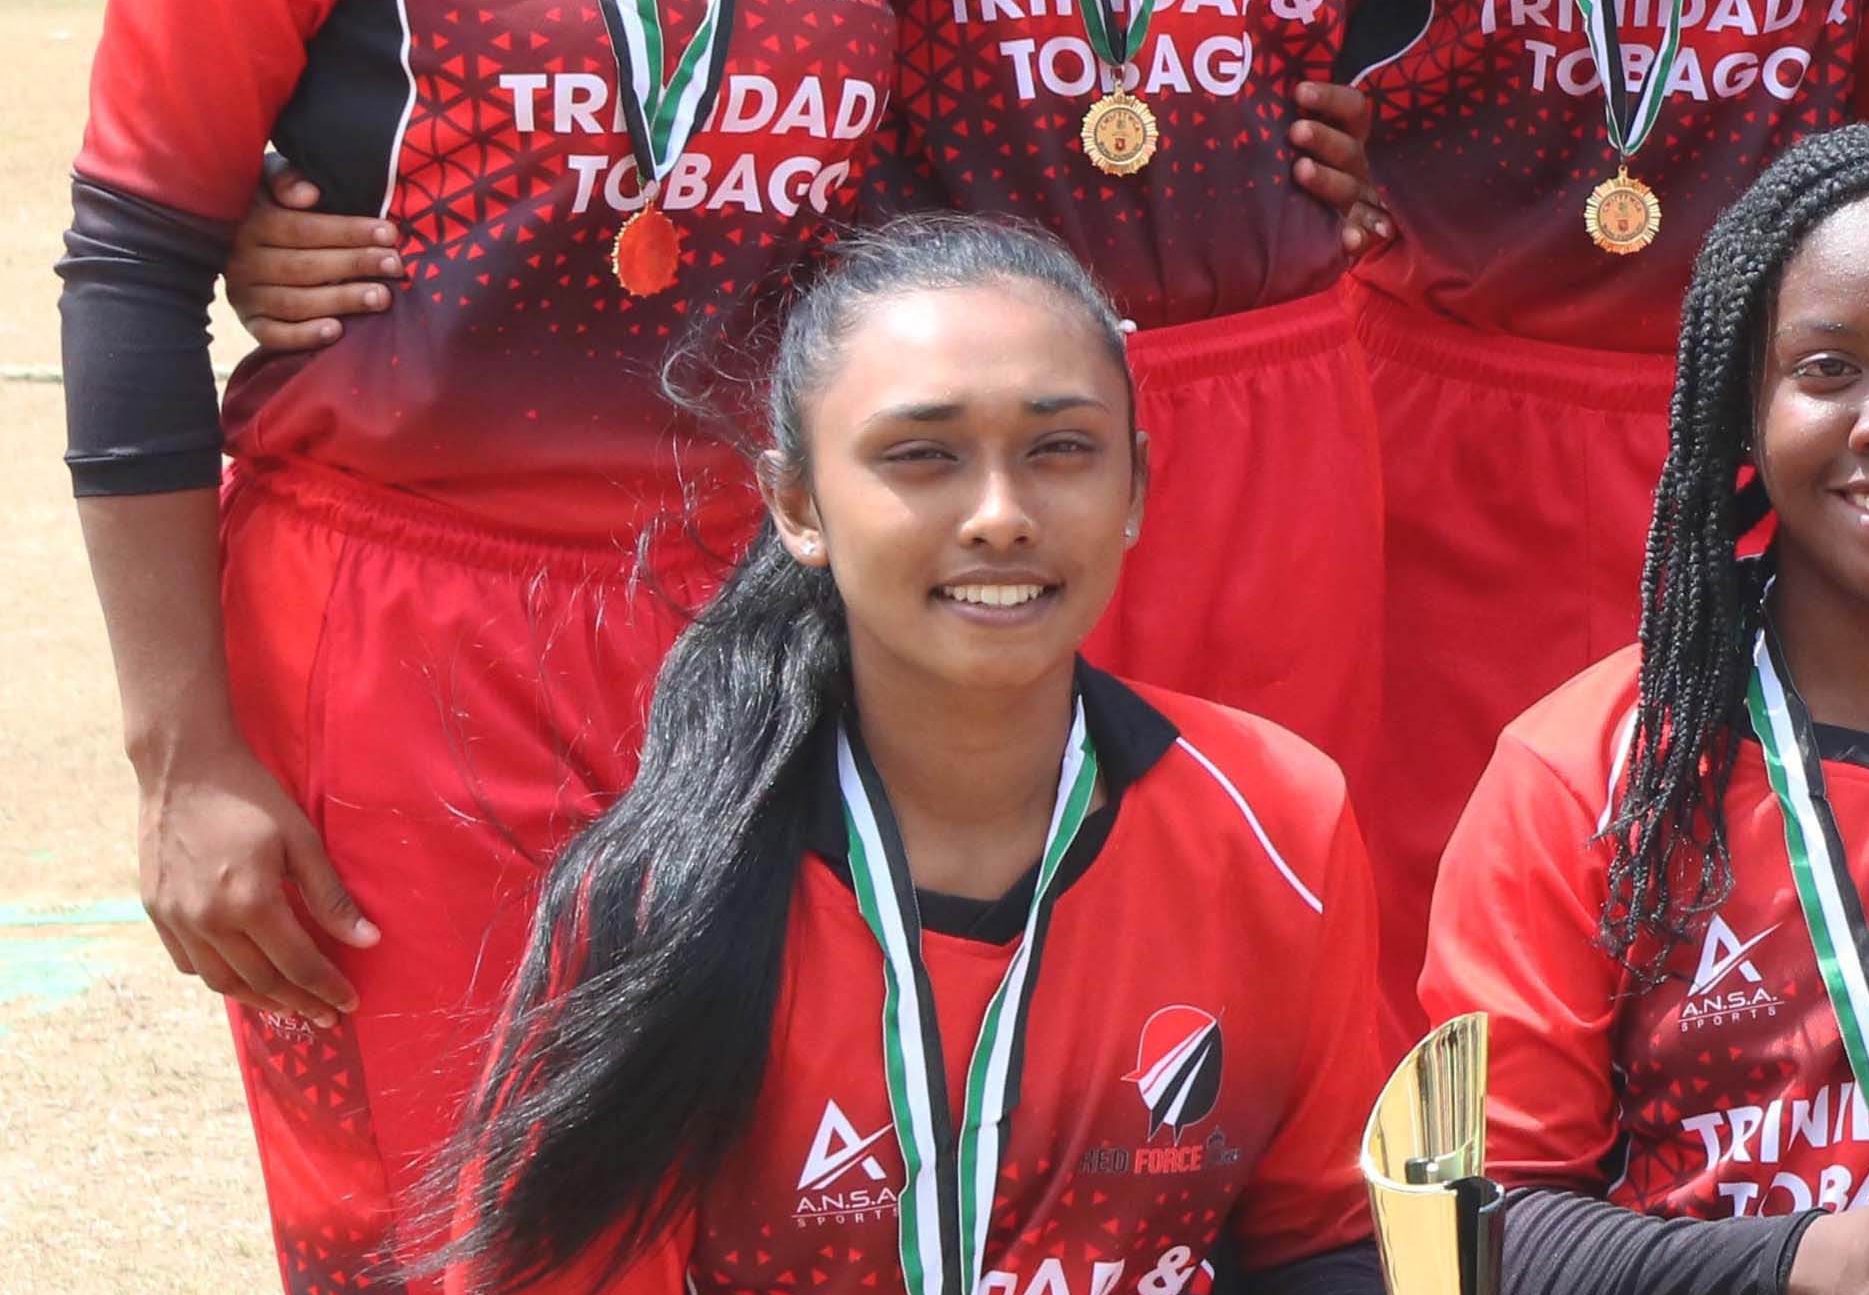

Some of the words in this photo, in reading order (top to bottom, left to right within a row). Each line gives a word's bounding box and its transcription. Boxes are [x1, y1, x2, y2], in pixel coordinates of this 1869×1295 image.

[1682, 988, 1778, 1018] A.N.S.A.
[1681, 1006, 1776, 1033] SPORTS
[1134, 1145, 1203, 1174] FORCE
